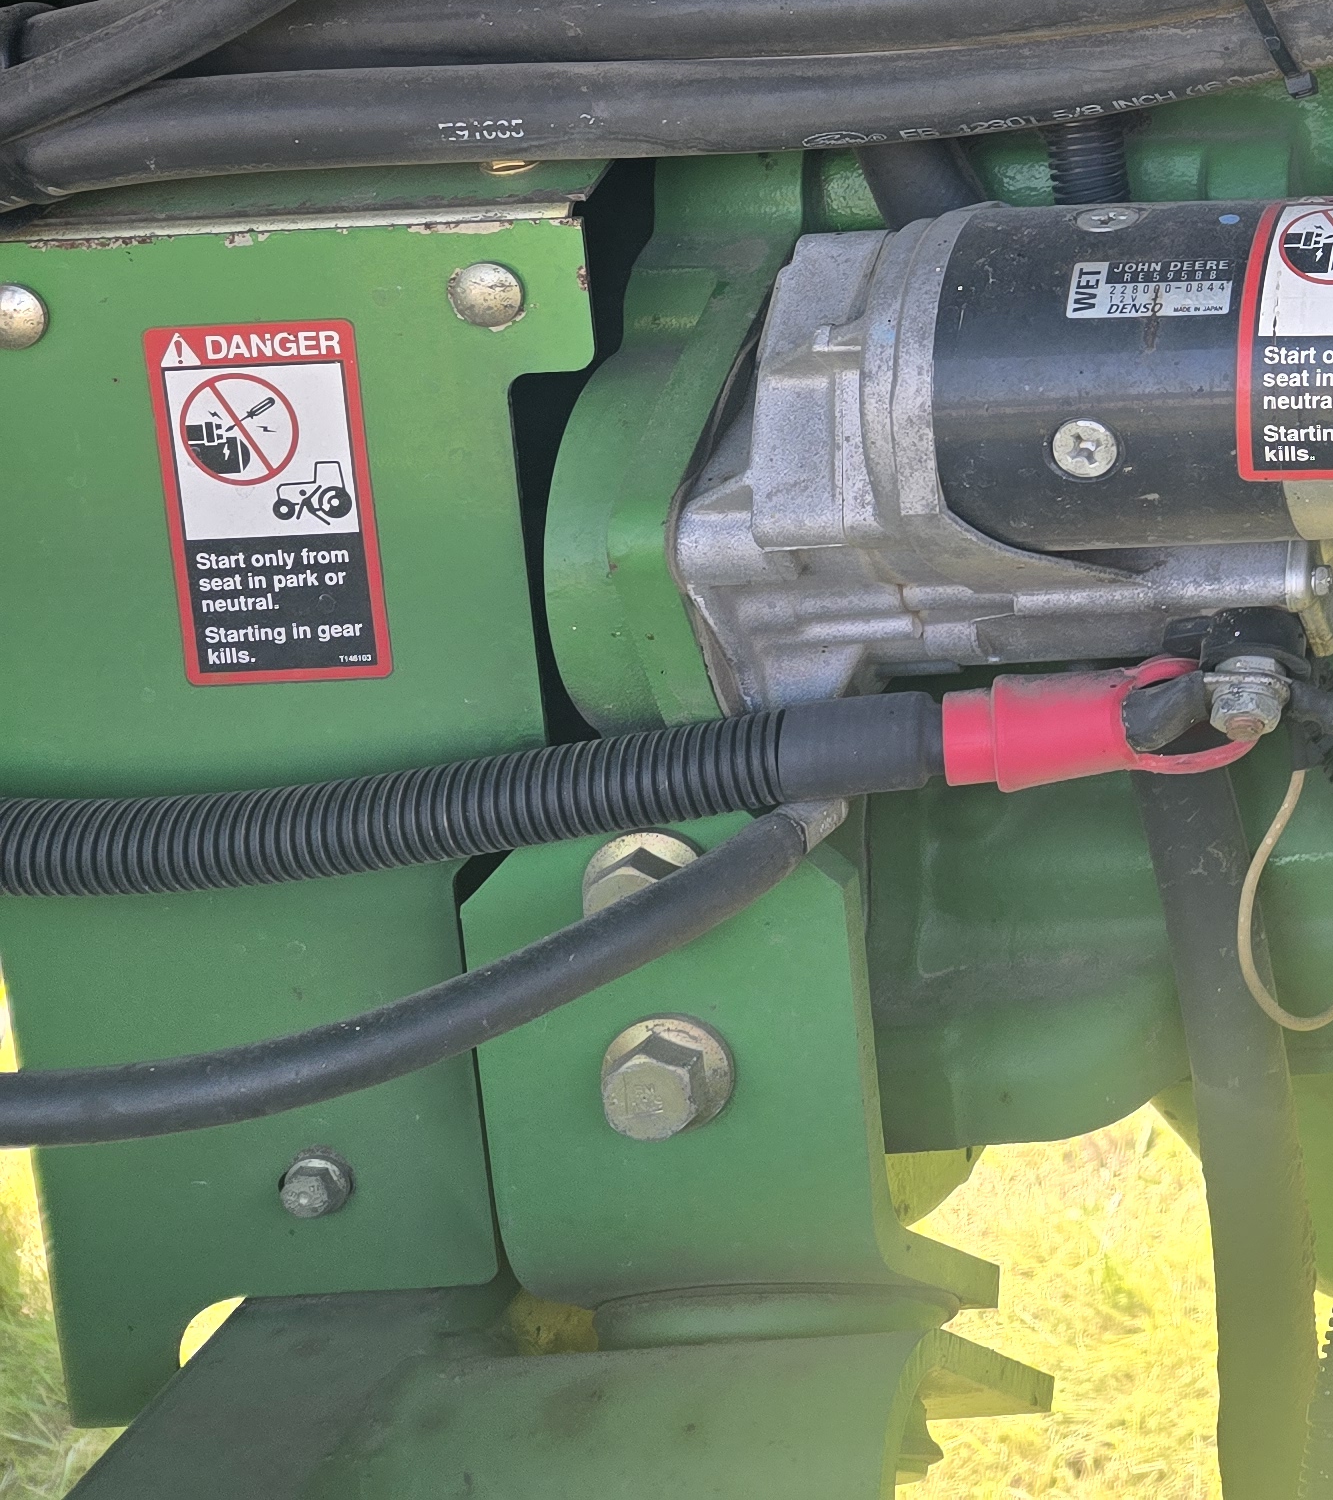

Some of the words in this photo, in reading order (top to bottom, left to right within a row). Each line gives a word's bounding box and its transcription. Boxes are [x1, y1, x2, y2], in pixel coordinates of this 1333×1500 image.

[1112, 89, 1178, 111] INCH
[1113, 261, 1162, 273] JOHN
[1169, 259, 1230, 272] DEERE
[1072, 267, 1102, 313] WET
[1106, 302, 1164, 315] DENSO
[205, 330, 342, 360] DANGER
[1263, 345, 1317, 366] Start
[1263, 368, 1310, 388] seat
[1264, 444, 1317, 463] kills.
[195, 551, 246, 570] Start
[251, 550, 295, 570] only
[300, 547, 350, 565] from
[199, 573, 243, 592] seat
[248, 571, 267, 590] in
[273, 569, 319, 594] park
[324, 570, 347, 586] or
[202, 593, 280, 613] neutral.
[205, 623, 287, 644] Starting
[291, 623, 312, 640] in
[317, 621, 364, 642] gear
[207, 648, 256, 665] kills.
